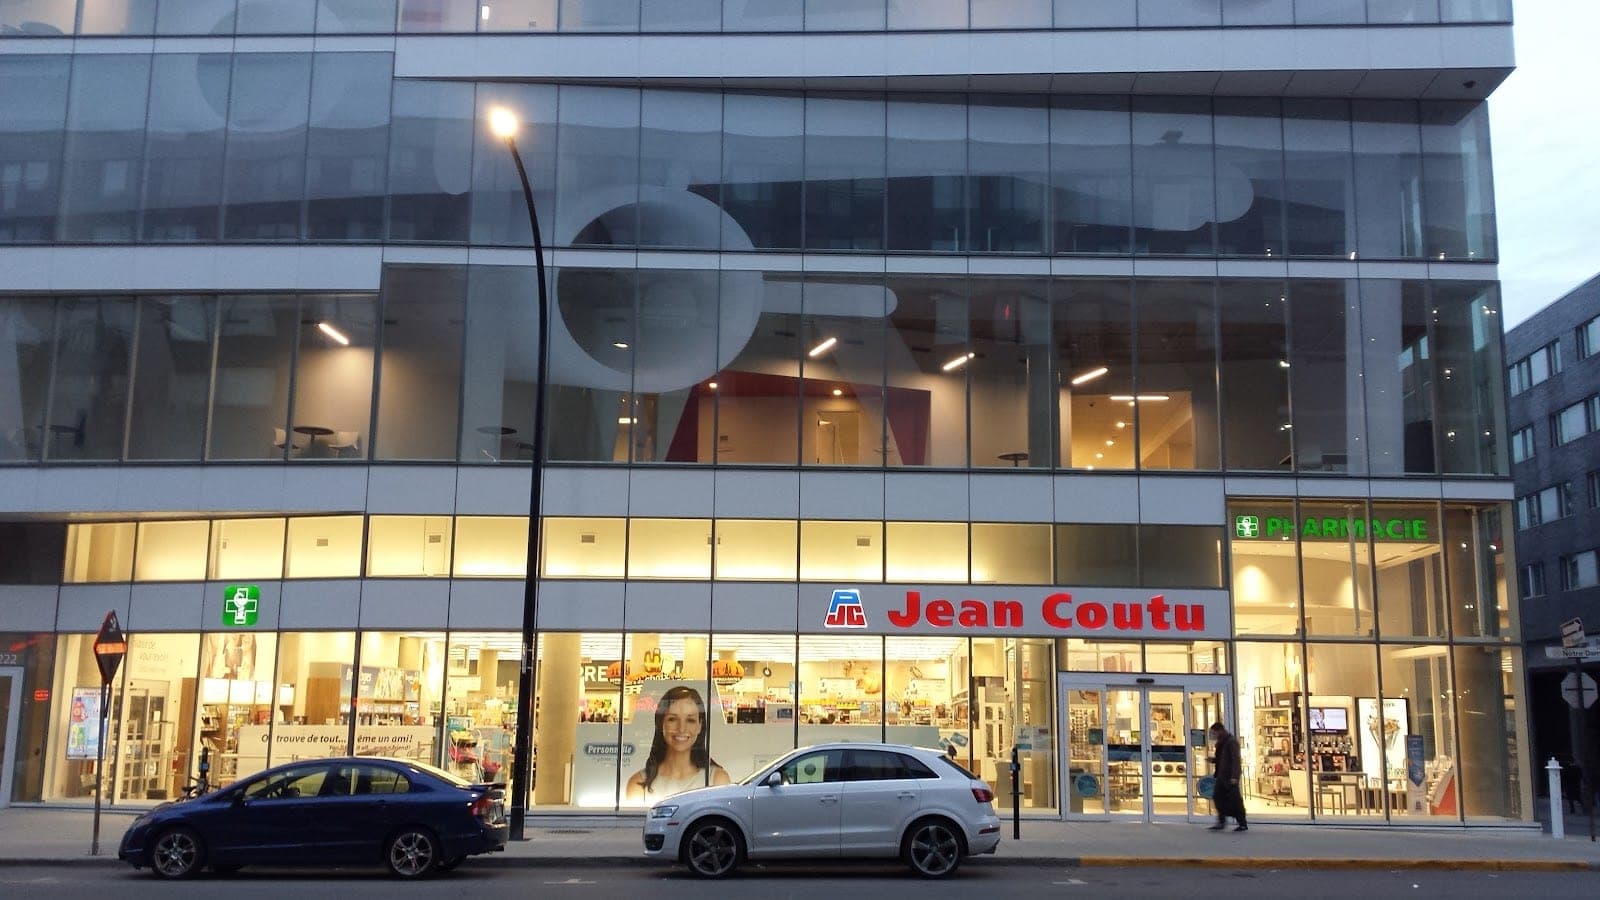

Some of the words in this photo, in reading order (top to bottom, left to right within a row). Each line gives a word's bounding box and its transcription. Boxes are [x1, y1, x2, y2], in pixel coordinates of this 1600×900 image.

[1265, 516, 1428, 539] PHARMACIE
[887, 591, 1024, 628] Jean
[1042, 593, 1206, 631] Coutu
[276, 735, 306, 743] trouve
[307, 733, 319, 743] de
[378, 735, 390, 743] un
[391, 733, 414, 743] ami!
